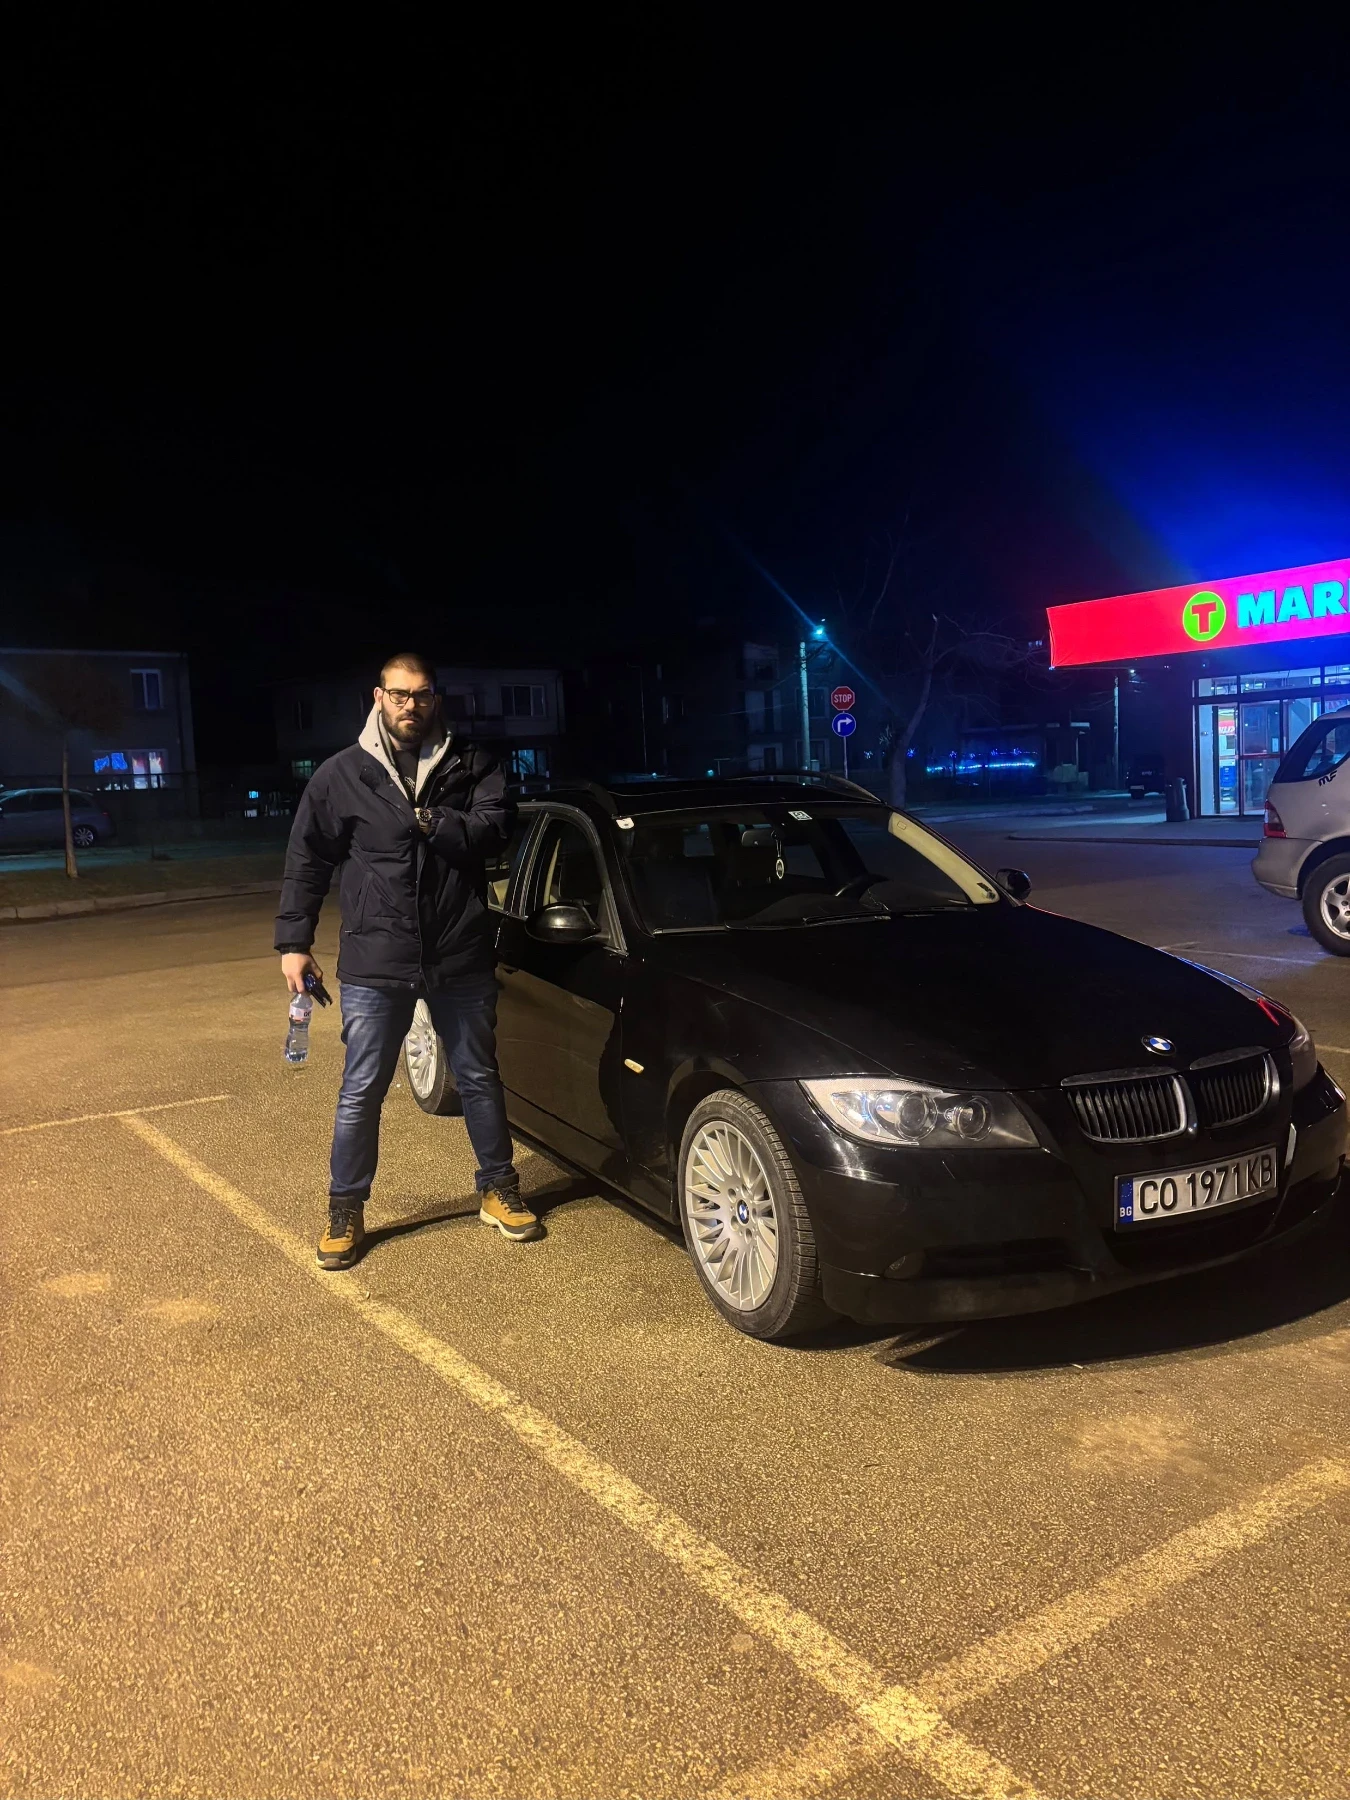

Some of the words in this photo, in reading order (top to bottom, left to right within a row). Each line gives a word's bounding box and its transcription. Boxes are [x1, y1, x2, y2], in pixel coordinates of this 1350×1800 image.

[1191, 601, 1217, 634] T
[1237, 577, 1350, 629] MAR
[834, 694, 852, 703] STOP
[1139, 1177, 1178, 1214] CO
[1185, 1164, 1241, 1208] 1971
[1246, 1153, 1272, 1192] KB
[1119, 1206, 1132, 1218] BG
